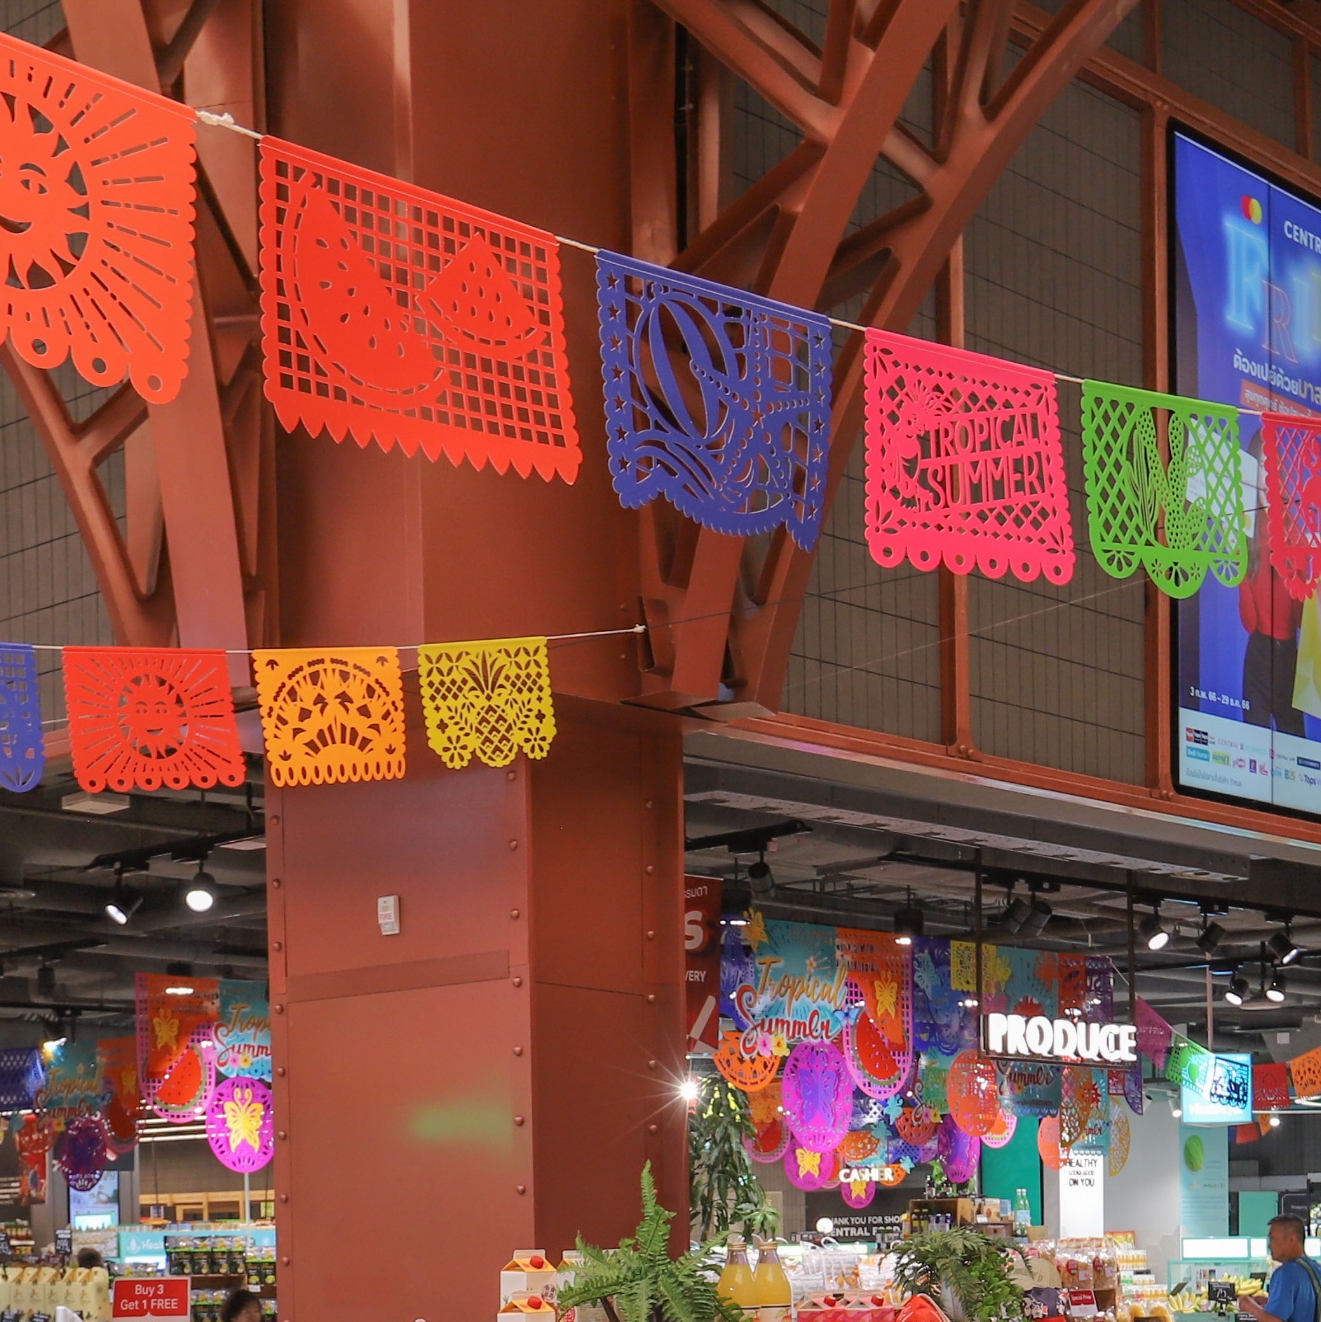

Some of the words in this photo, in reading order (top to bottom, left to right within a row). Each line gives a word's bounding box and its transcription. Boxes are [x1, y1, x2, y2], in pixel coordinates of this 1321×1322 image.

[928, 411, 1042, 460] TROPICAL
[927, 452, 1046, 512] SUMMER
[757, 957, 848, 1017] Tropical
[735, 984, 834, 1054] Summer
[988, 1012, 1138, 1063] PRODUCE
[830, 1227, 870, 1237] ENTRAL
[850, 1216, 866, 1226] YOU
[868, 1216, 883, 1225] FOR
[120, 1299, 139, 1311] Get
[142, 1300, 147, 1310] 1
[150, 1299, 178, 1310] FREE
[135, 1284, 154, 1296] Buy
[157, 1284, 164, 1295] 3
